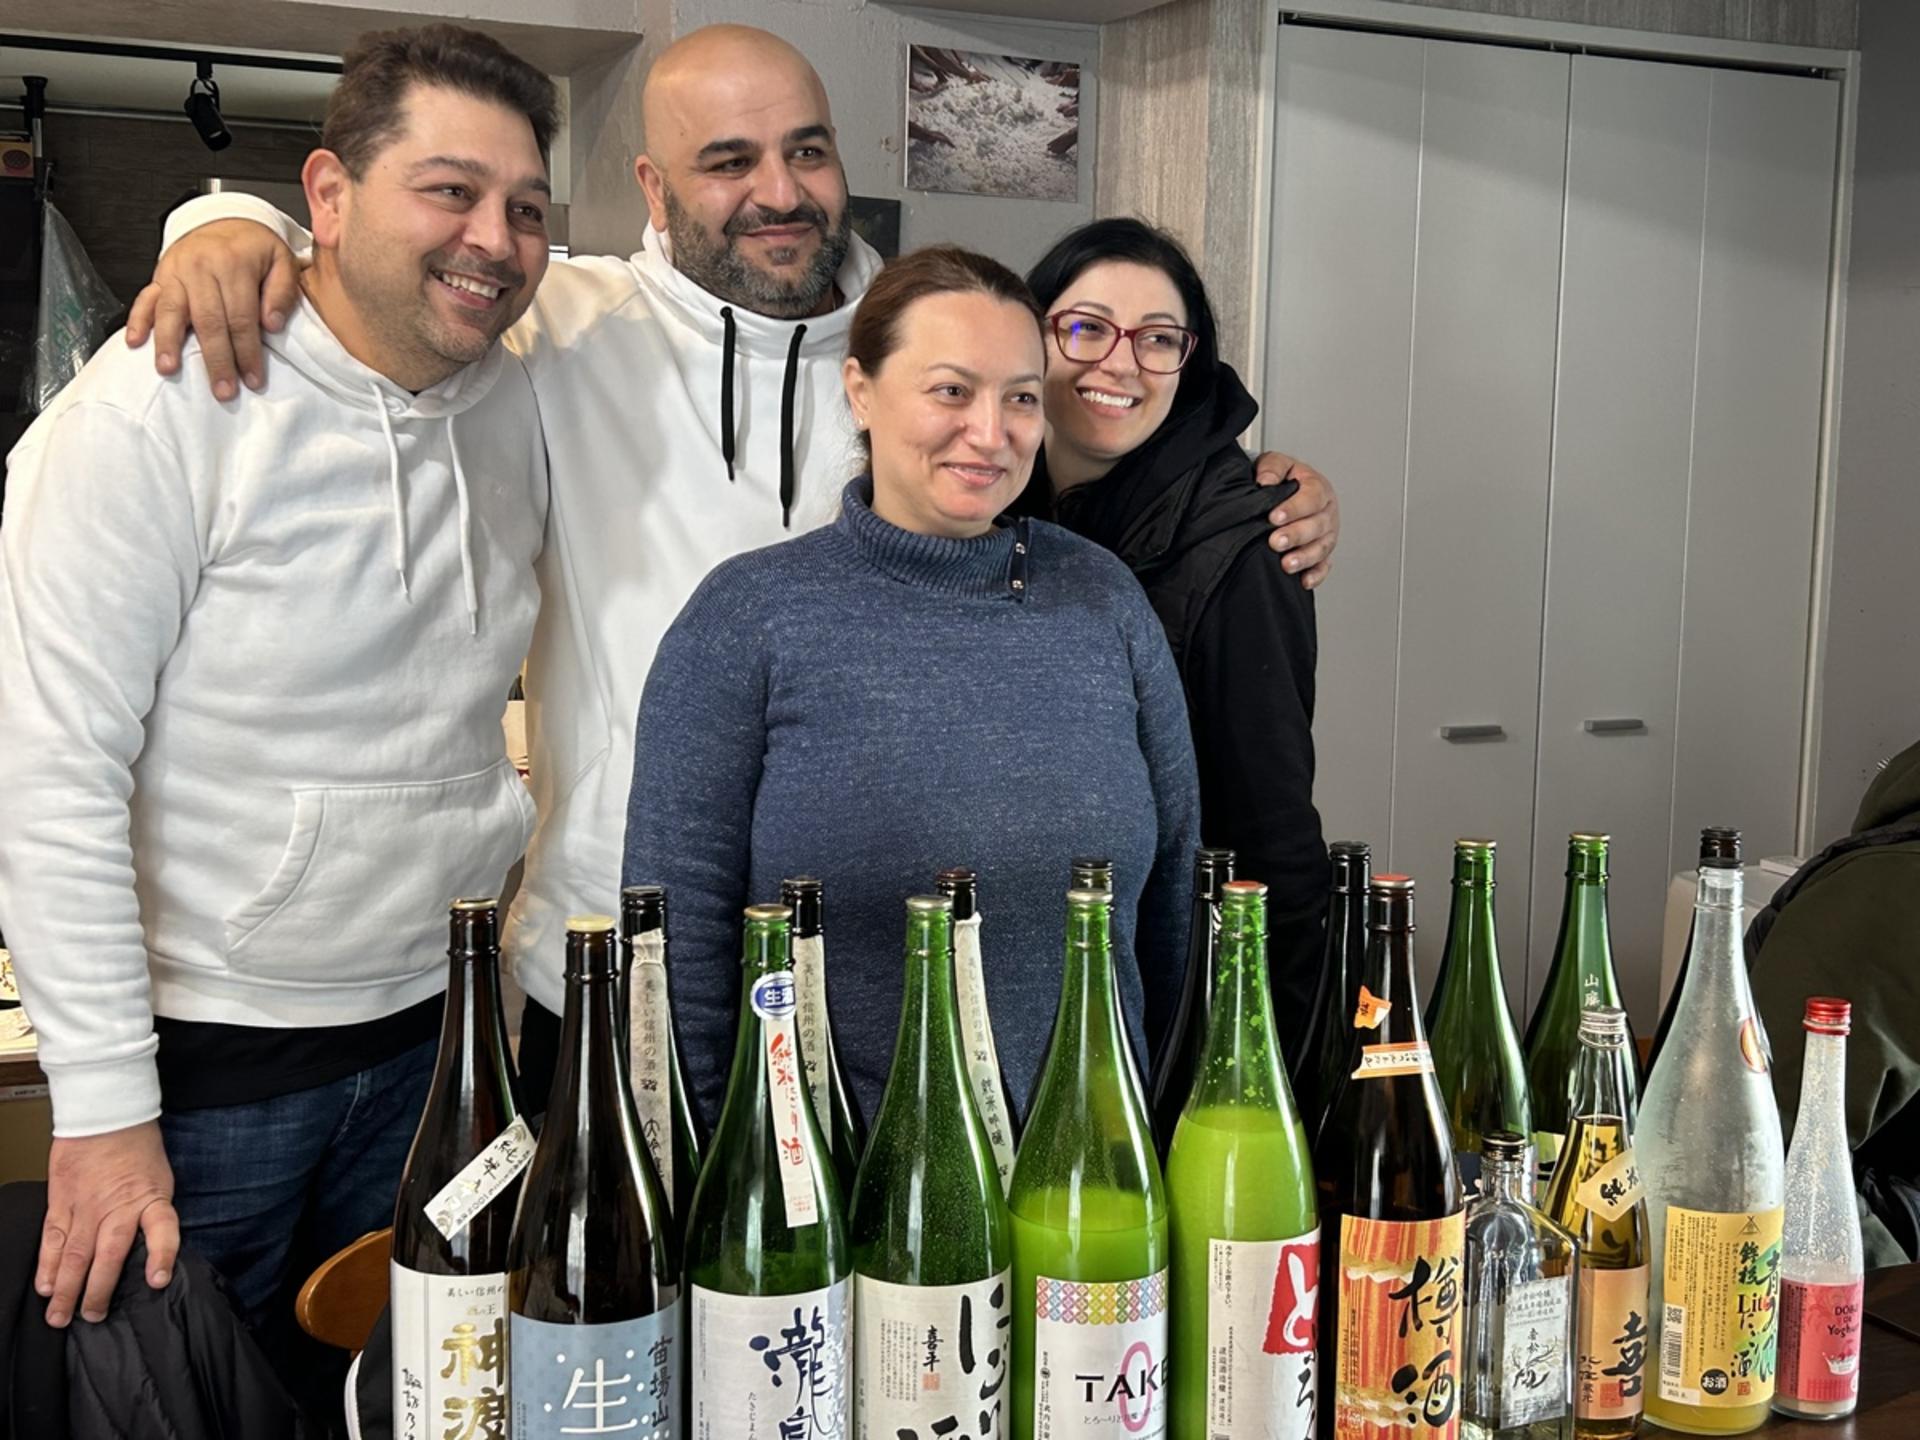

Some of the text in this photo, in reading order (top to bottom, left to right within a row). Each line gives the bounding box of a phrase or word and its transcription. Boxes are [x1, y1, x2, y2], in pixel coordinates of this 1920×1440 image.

[643, 979, 657, 1071] 美しい信州の酒
[802, 964, 816, 1051] 美しい信州の酒
[647, 1335, 674, 1428] 苗場山
[921, 1324, 944, 1373] 喜平
[1702, 1375, 1727, 1389] お酒
[559, 1357, 638, 1433] 生
